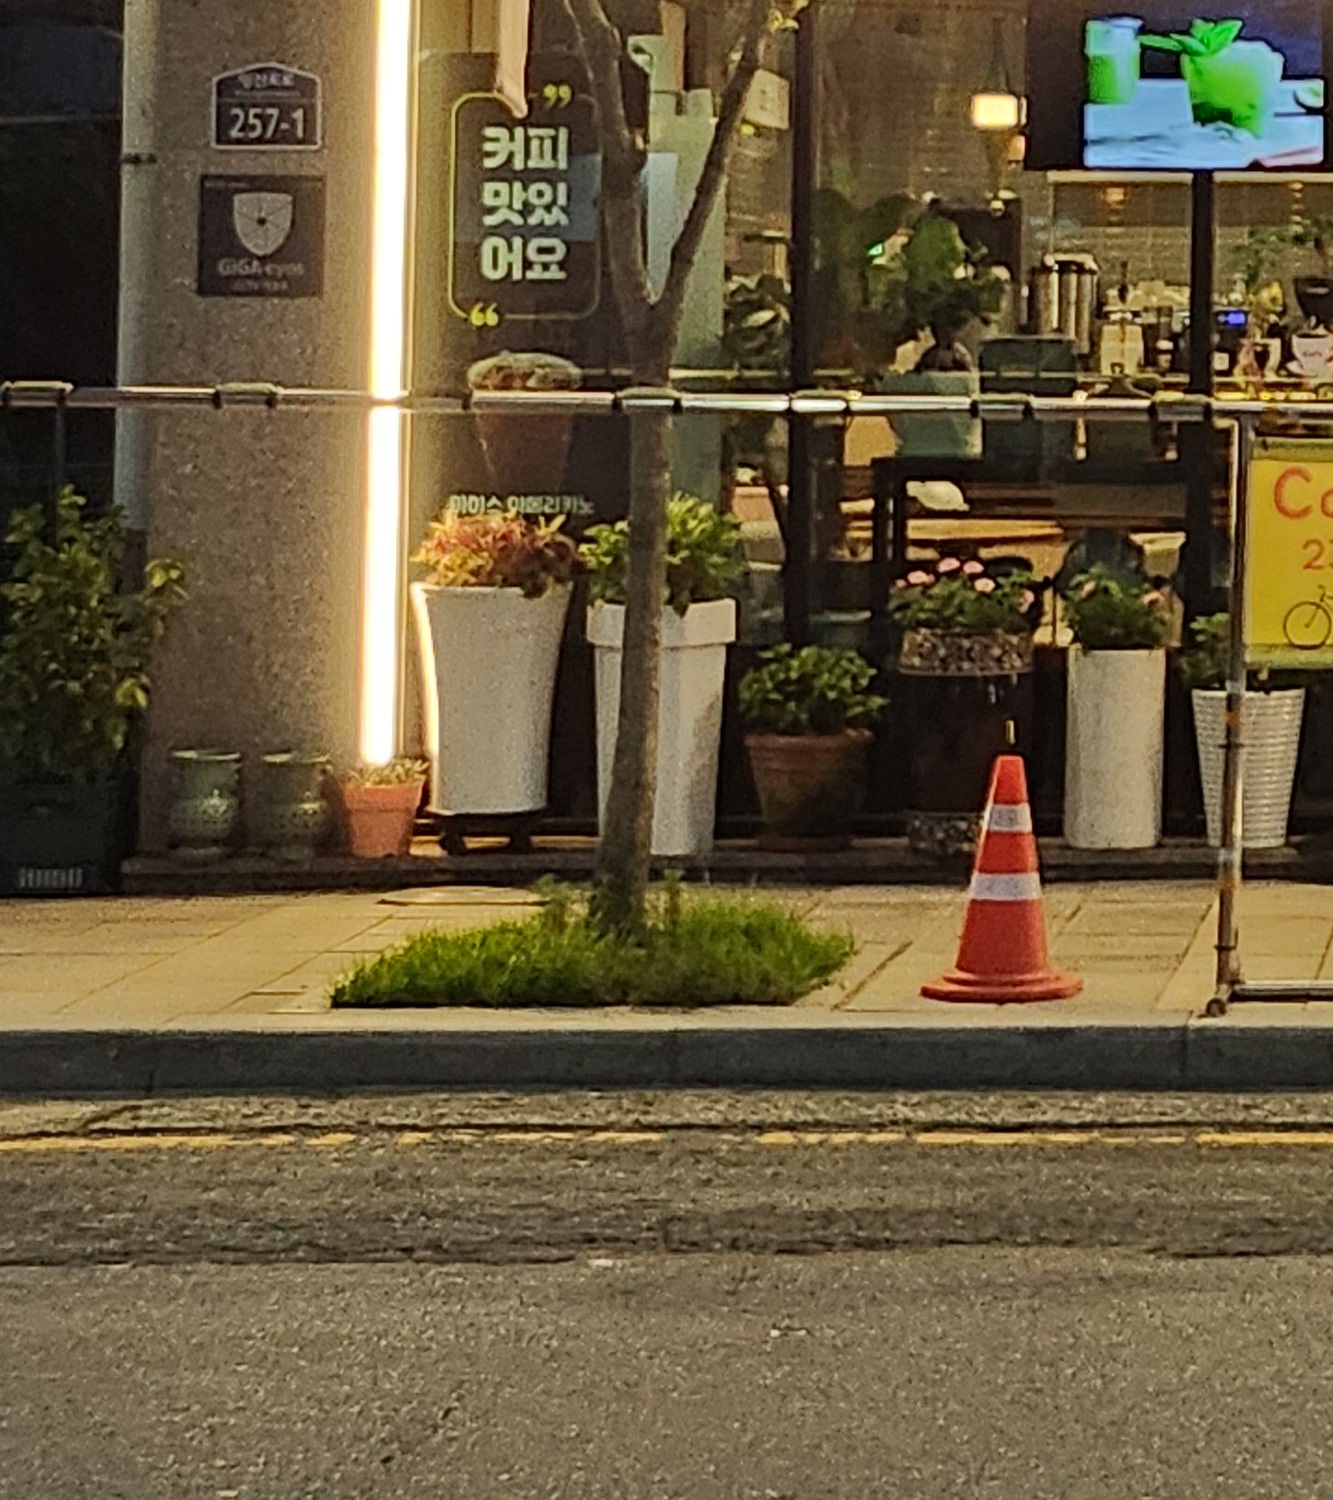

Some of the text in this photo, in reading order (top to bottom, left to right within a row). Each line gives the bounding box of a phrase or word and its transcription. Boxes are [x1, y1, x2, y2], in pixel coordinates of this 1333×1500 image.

[229, 107, 304, 139] 257-1
[481, 126, 569, 171] 커피
[481, 181, 569, 227] 맛있
[480, 236, 568, 281] 어요
